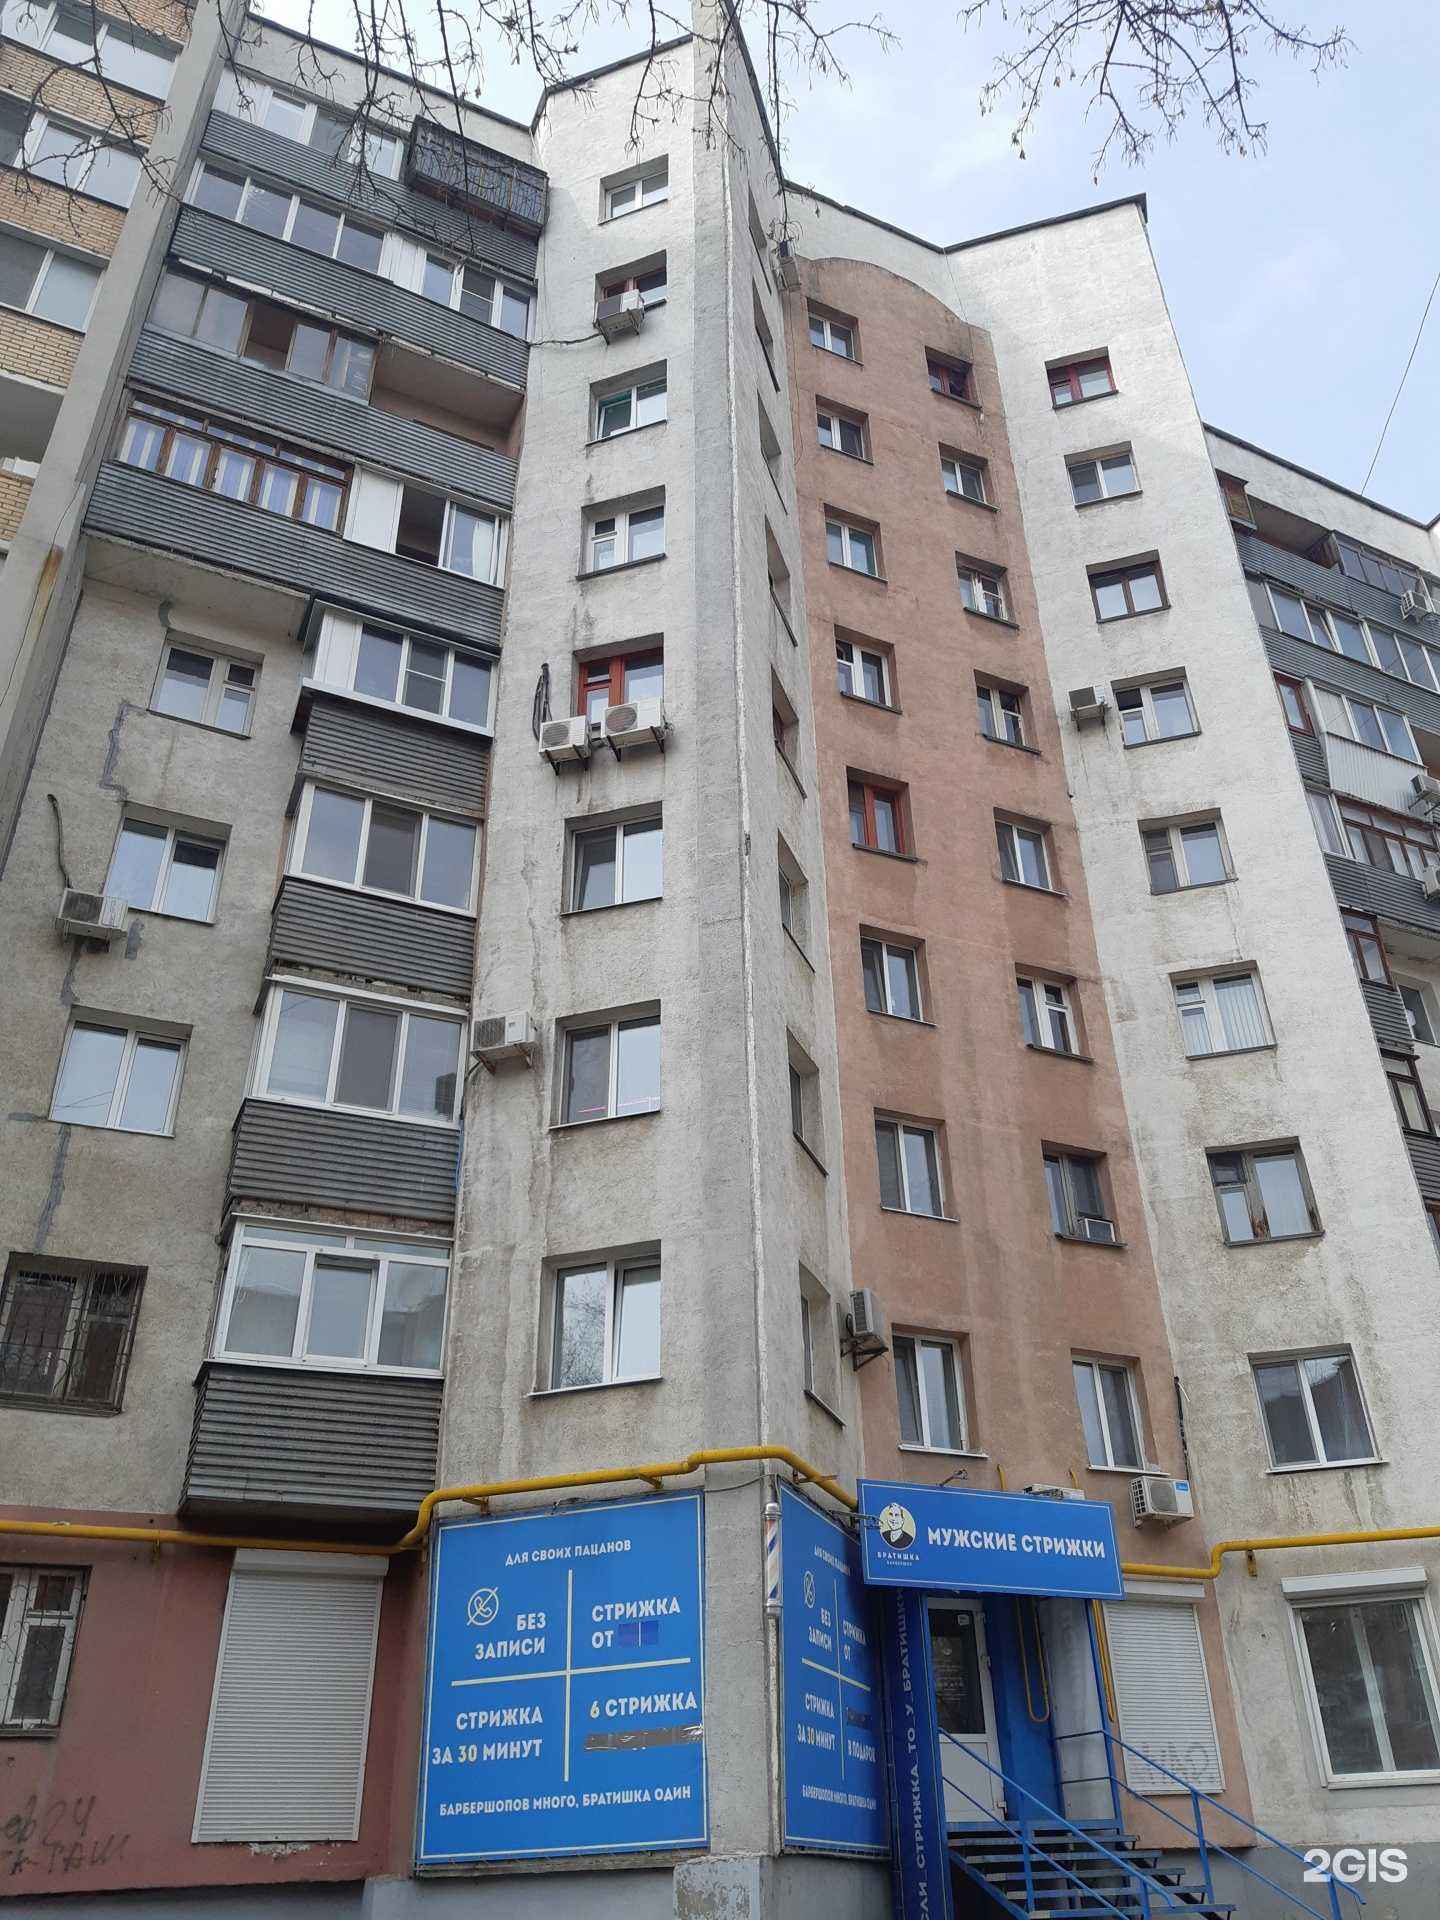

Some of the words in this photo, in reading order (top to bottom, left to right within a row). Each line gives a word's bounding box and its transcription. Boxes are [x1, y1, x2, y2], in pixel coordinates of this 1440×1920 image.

[505, 1552, 529, 1566] ДЛЯ
[531, 1547, 571, 1562] СВОИХ
[574, 1539, 632, 1557] ПАЦАНОВ
[927, 1526, 1018, 1552] МУЖСКИЕ
[1021, 1534, 1106, 1559] СТРИЖКИ
[877, 1551, 920, 1561] БРАТИШКА
[516, 1612, 546, 1631] БЕЗ
[591, 1597, 681, 1622] СТРИЖКА
[474, 1636, 545, 1660] ЗАПИСИ
[591, 1630, 614, 1649] ОТ
[589, 1700, 600, 1719] 6
[605, 1691, 698, 1717] СТРИЖКА
[456, 1706, 543, 1731] СТРИЖКА
[431, 1746, 453, 1765] ЗА
[458, 1744, 478, 1763] 30
[482, 1739, 543, 1761] МИНУТ
[439, 1797, 530, 1816] БАРБЕРШОПОВ
[582, 1790, 651, 1807] БРАТИШКА
[654, 1785, 691, 1800] ОДИН
